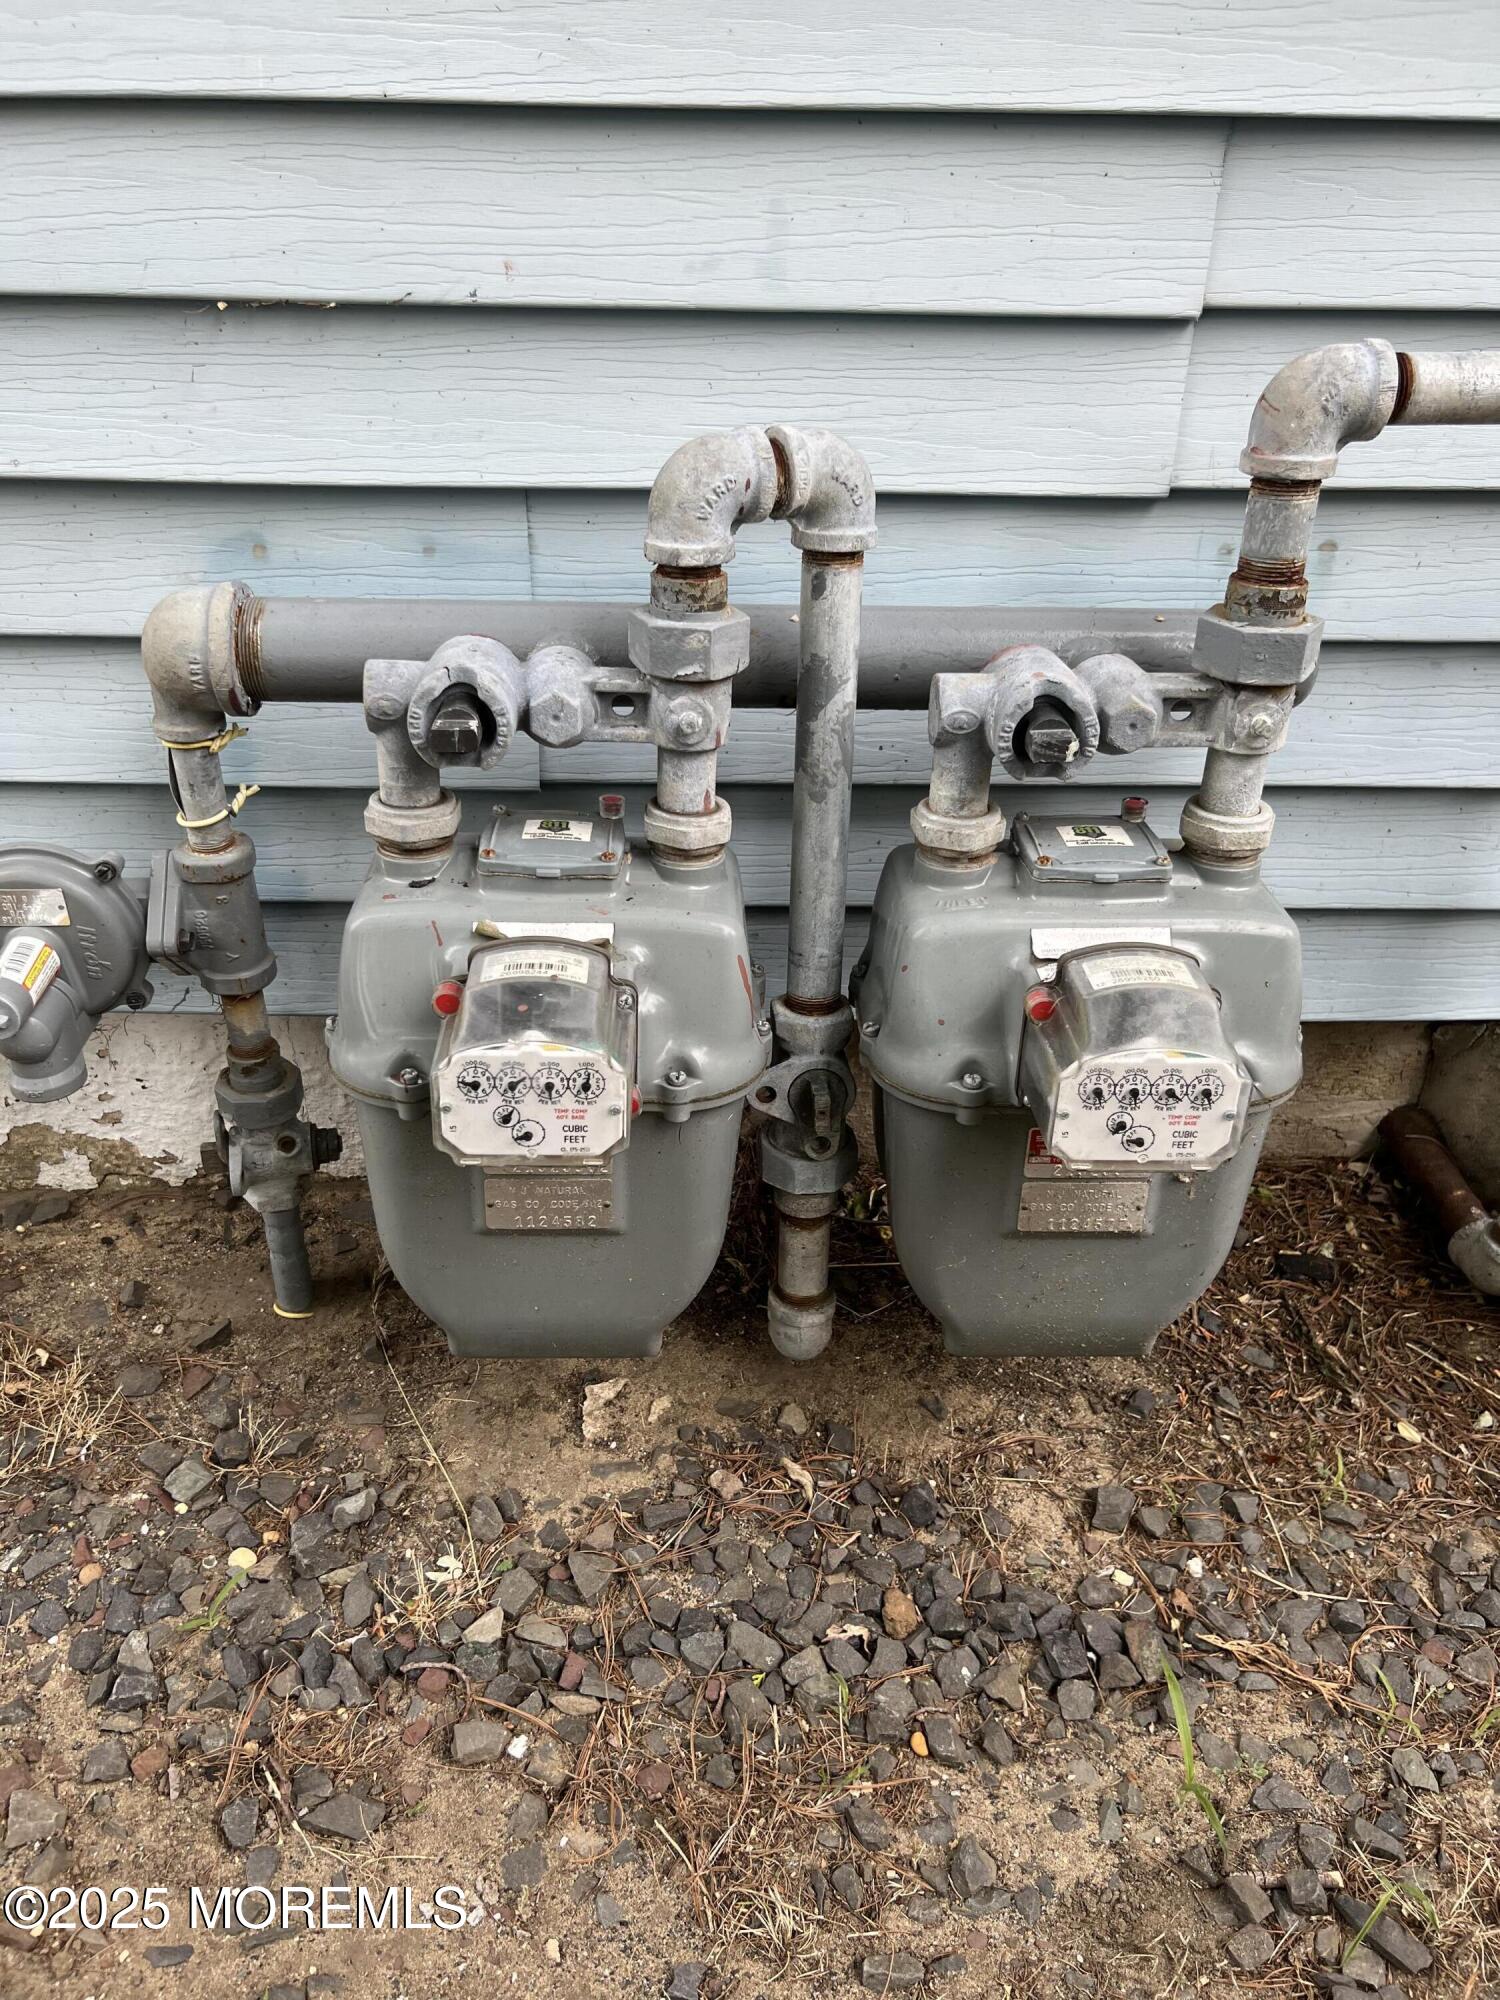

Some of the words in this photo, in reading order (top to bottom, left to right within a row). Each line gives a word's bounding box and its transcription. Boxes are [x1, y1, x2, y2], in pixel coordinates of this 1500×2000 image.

[696, 474, 736, 520] WARD
[535, 1186, 586, 1195] NATURAL
[495, 1200, 517, 1208] GAS
